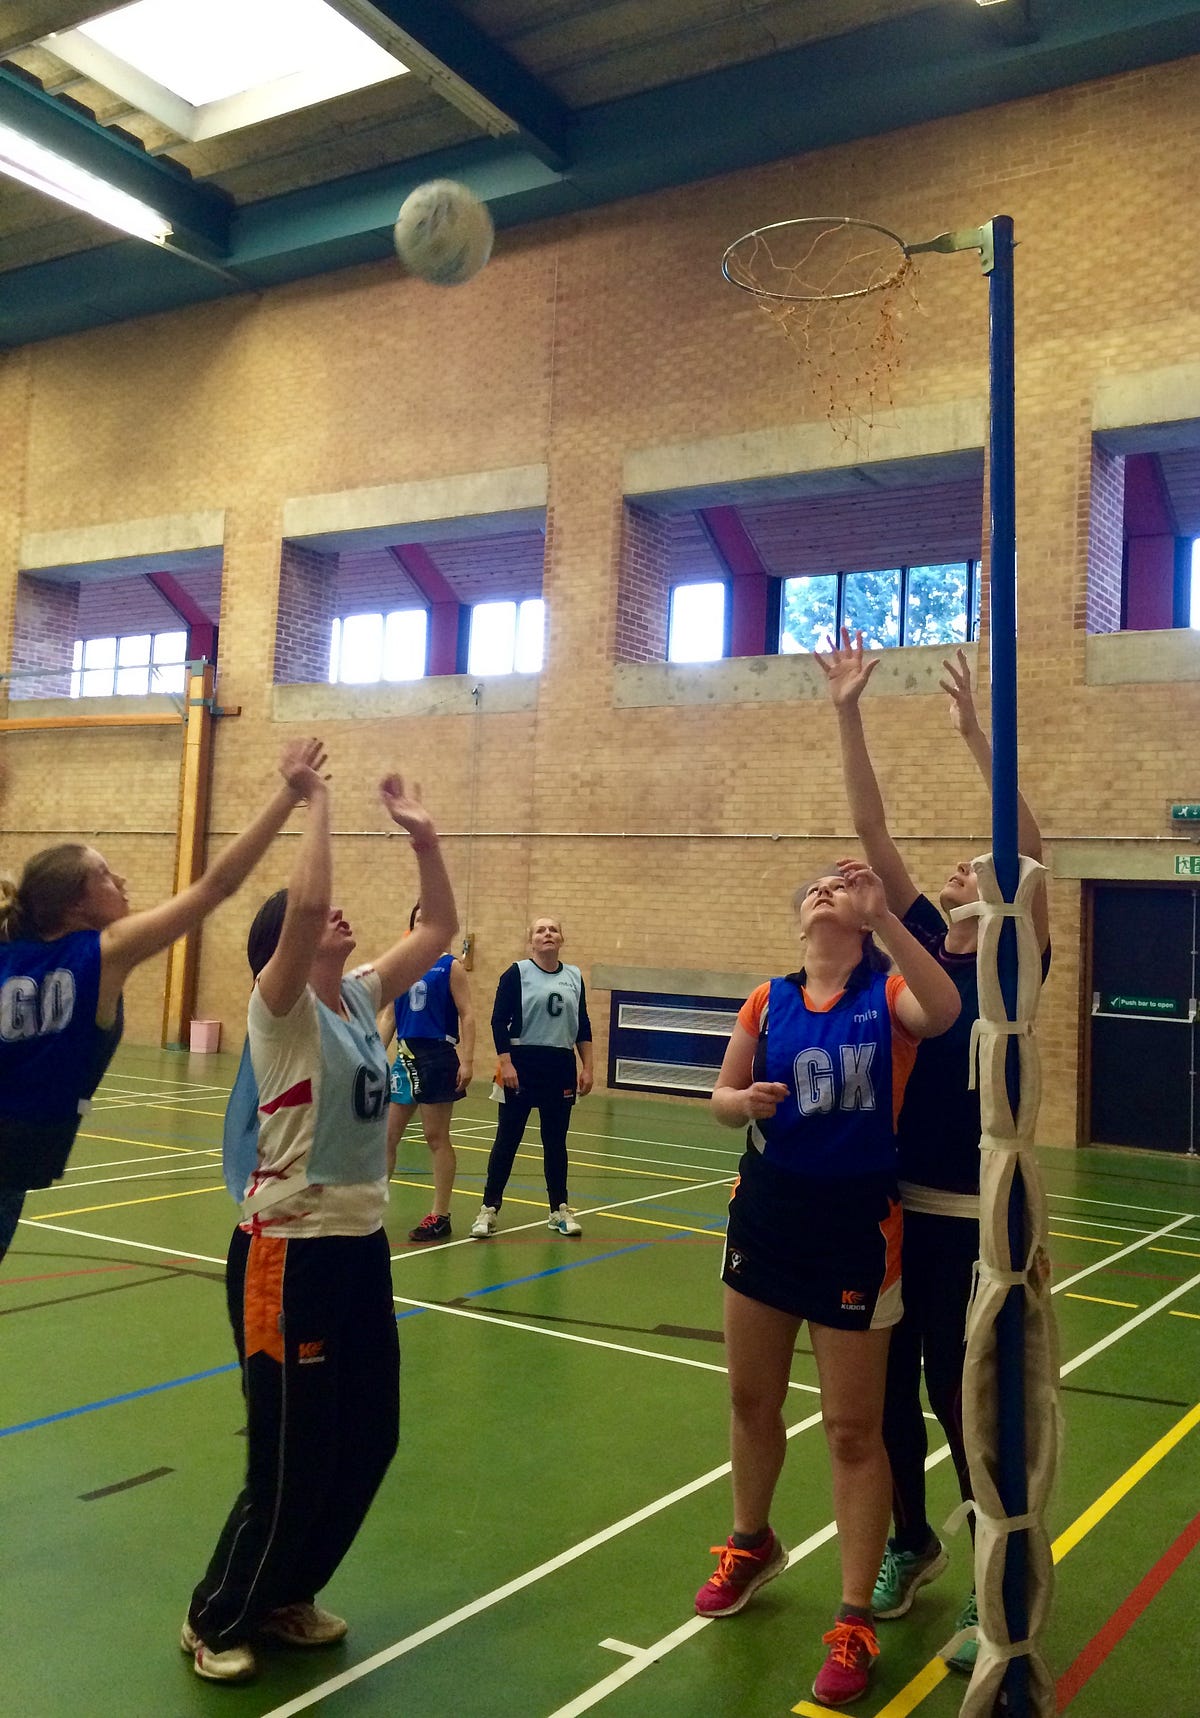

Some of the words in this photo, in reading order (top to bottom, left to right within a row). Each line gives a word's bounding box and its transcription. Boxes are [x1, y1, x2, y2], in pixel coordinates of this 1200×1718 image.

[547, 991, 564, 1017] C
[1120, 998, 1137, 1006] Push
[793, 1041, 877, 1117] GK
